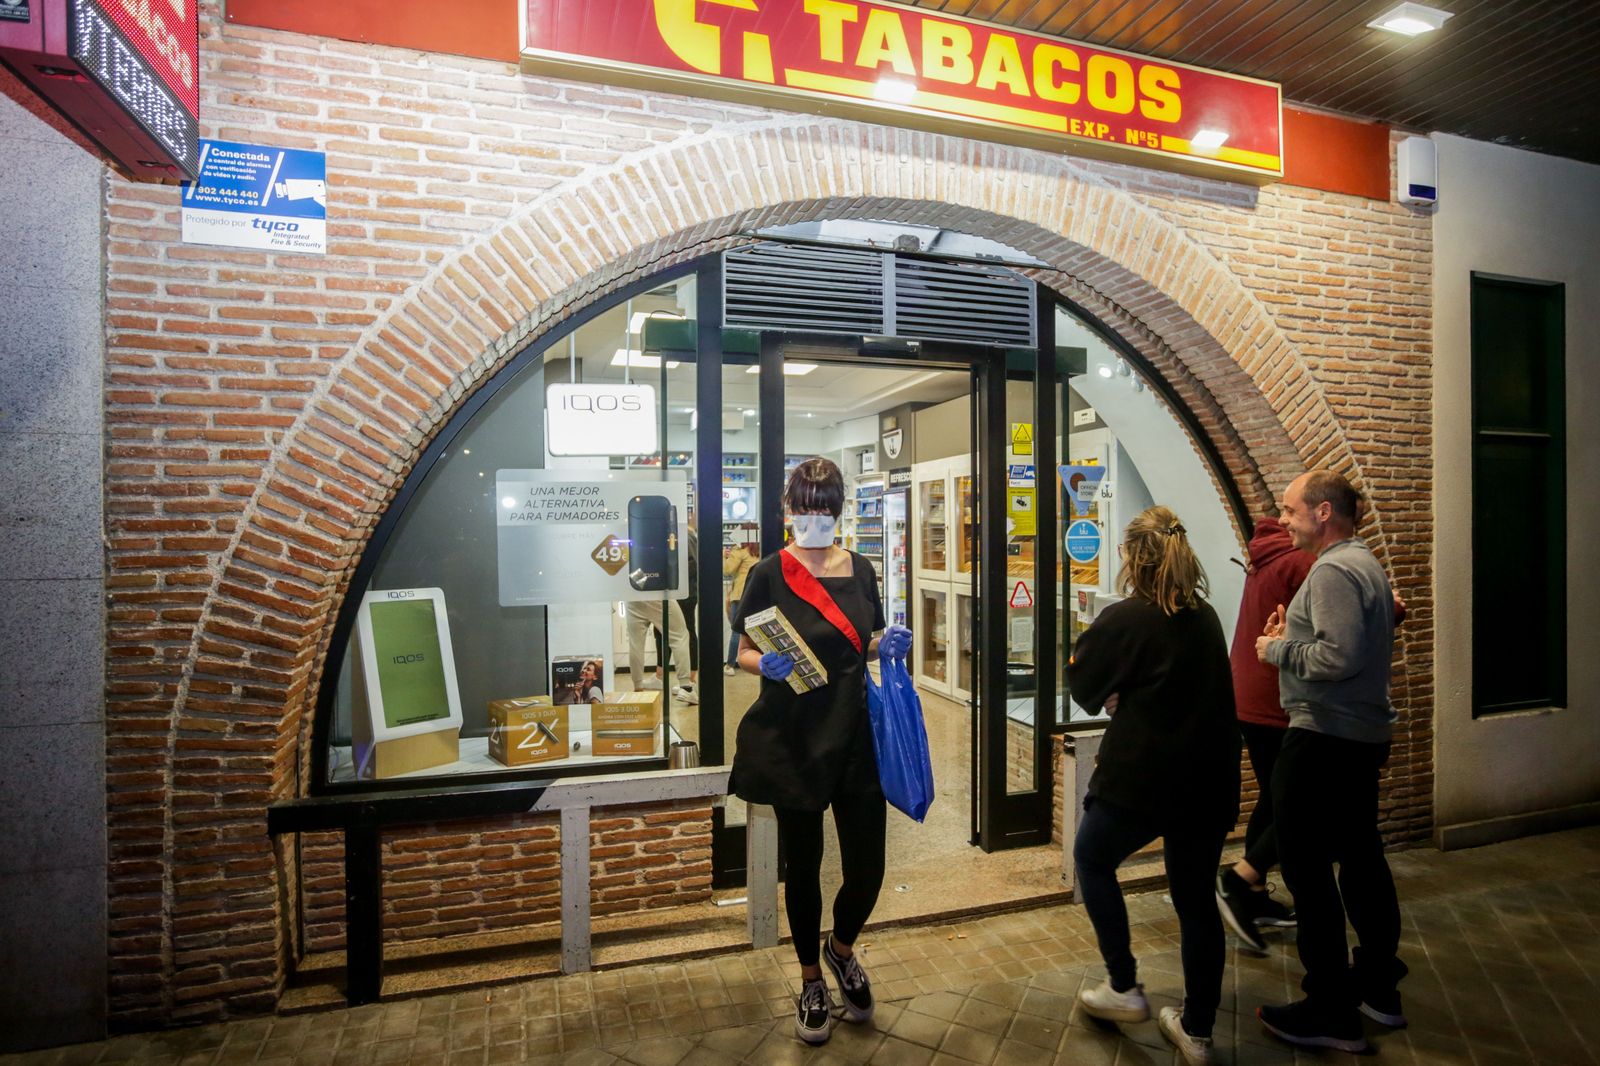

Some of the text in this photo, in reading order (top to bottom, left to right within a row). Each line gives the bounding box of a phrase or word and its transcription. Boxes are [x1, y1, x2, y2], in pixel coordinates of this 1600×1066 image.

[804, 0, 1182, 124] TABACOS
[1070, 118, 1159, 149] EXP. Nº5
[211, 148, 270, 162] Conectada
[214, 157, 236, 166] central
[246, 161, 271, 169] alarmas
[219, 166, 256, 174] verificación
[198, 187, 259, 199] 902 444 440
[195, 194, 259, 206] www.tyco.es
[185, 213, 299, 233] Protegido por tyco
[273, 231, 310, 241] Integrated
[294, 240, 322, 250] Security
[563, 395, 641, 414] IQOS
[890, 471, 911, 484] REFRESCO
[530, 486, 600, 496] UNA MEJOR
[1101, 489, 1113, 499] blu
[524, 499, 605, 509] ALTERNATIVA
[510, 511, 620, 521] PARA FUMADORES
[387, 590, 415, 599] IQOS
[393, 653, 424, 665] IQOS
